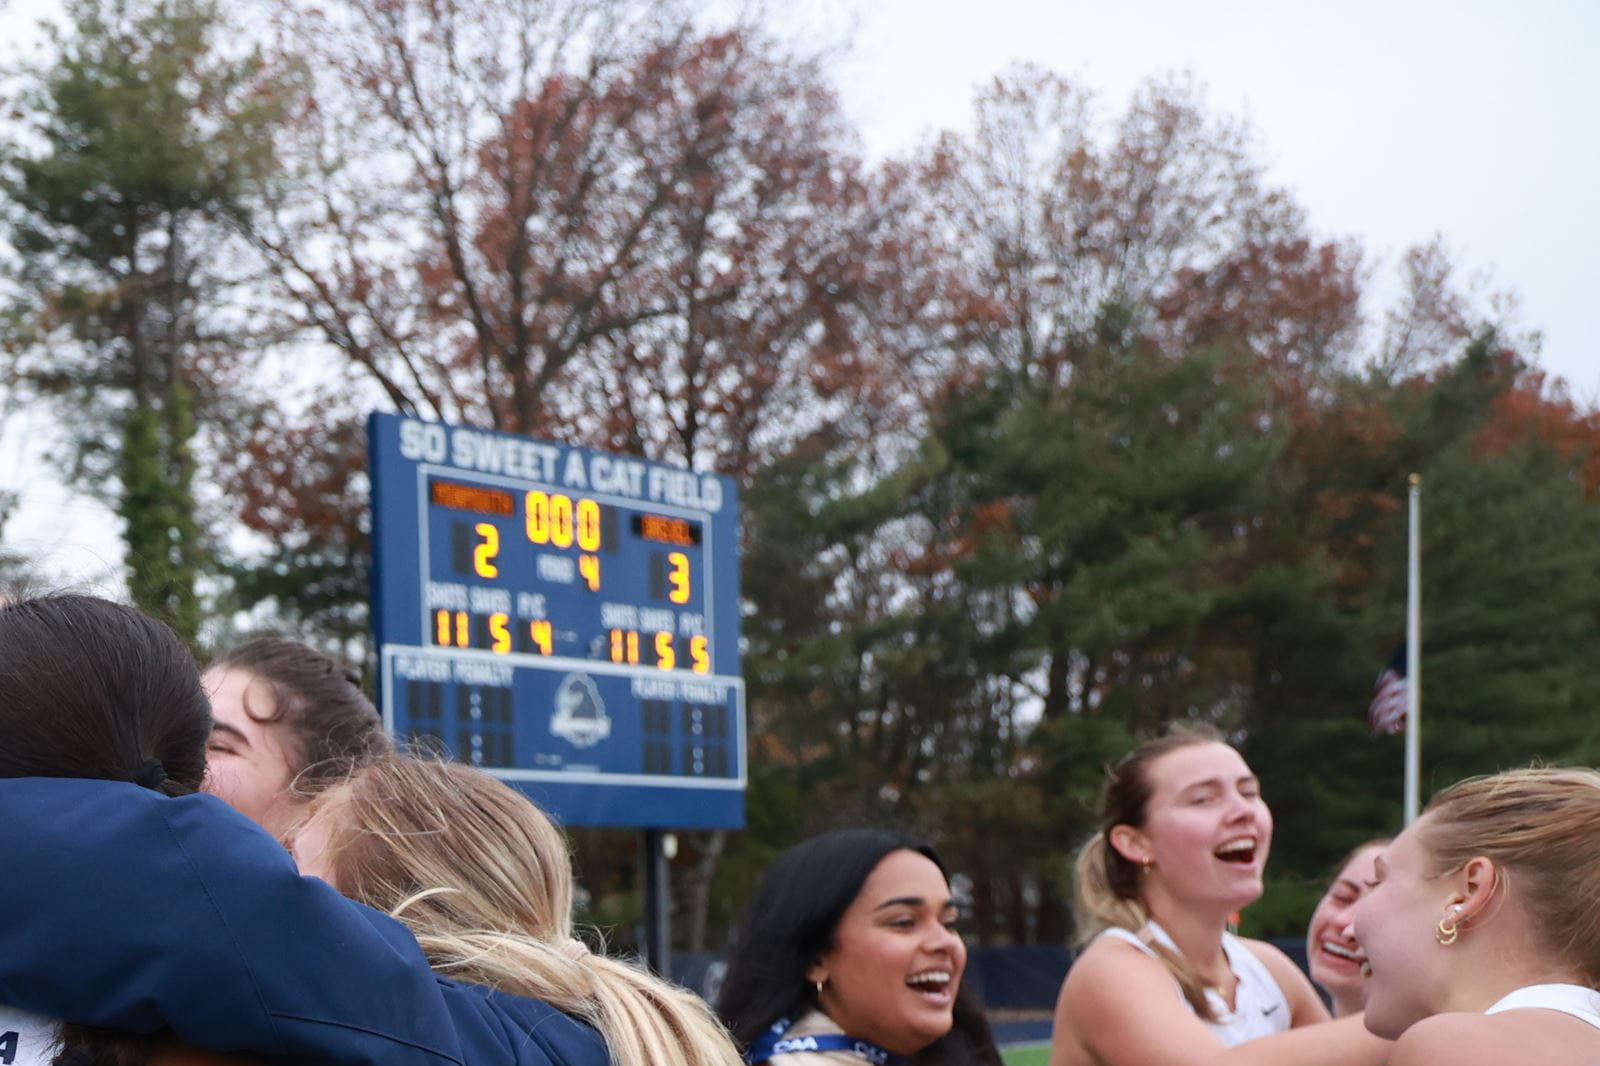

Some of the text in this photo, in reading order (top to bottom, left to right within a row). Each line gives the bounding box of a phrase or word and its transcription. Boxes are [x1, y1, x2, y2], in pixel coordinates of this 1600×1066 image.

[400, 418, 724, 513] SO SWEET A CAT FIELD
[474, 522, 499, 578] 2
[578, 554, 600, 592] 4
[668, 552, 690, 605] 3
[437, 609, 552, 656] 11 5 4
[610, 627, 710, 676] 11 5 5
[773, 1036, 818, 1054] CAA
